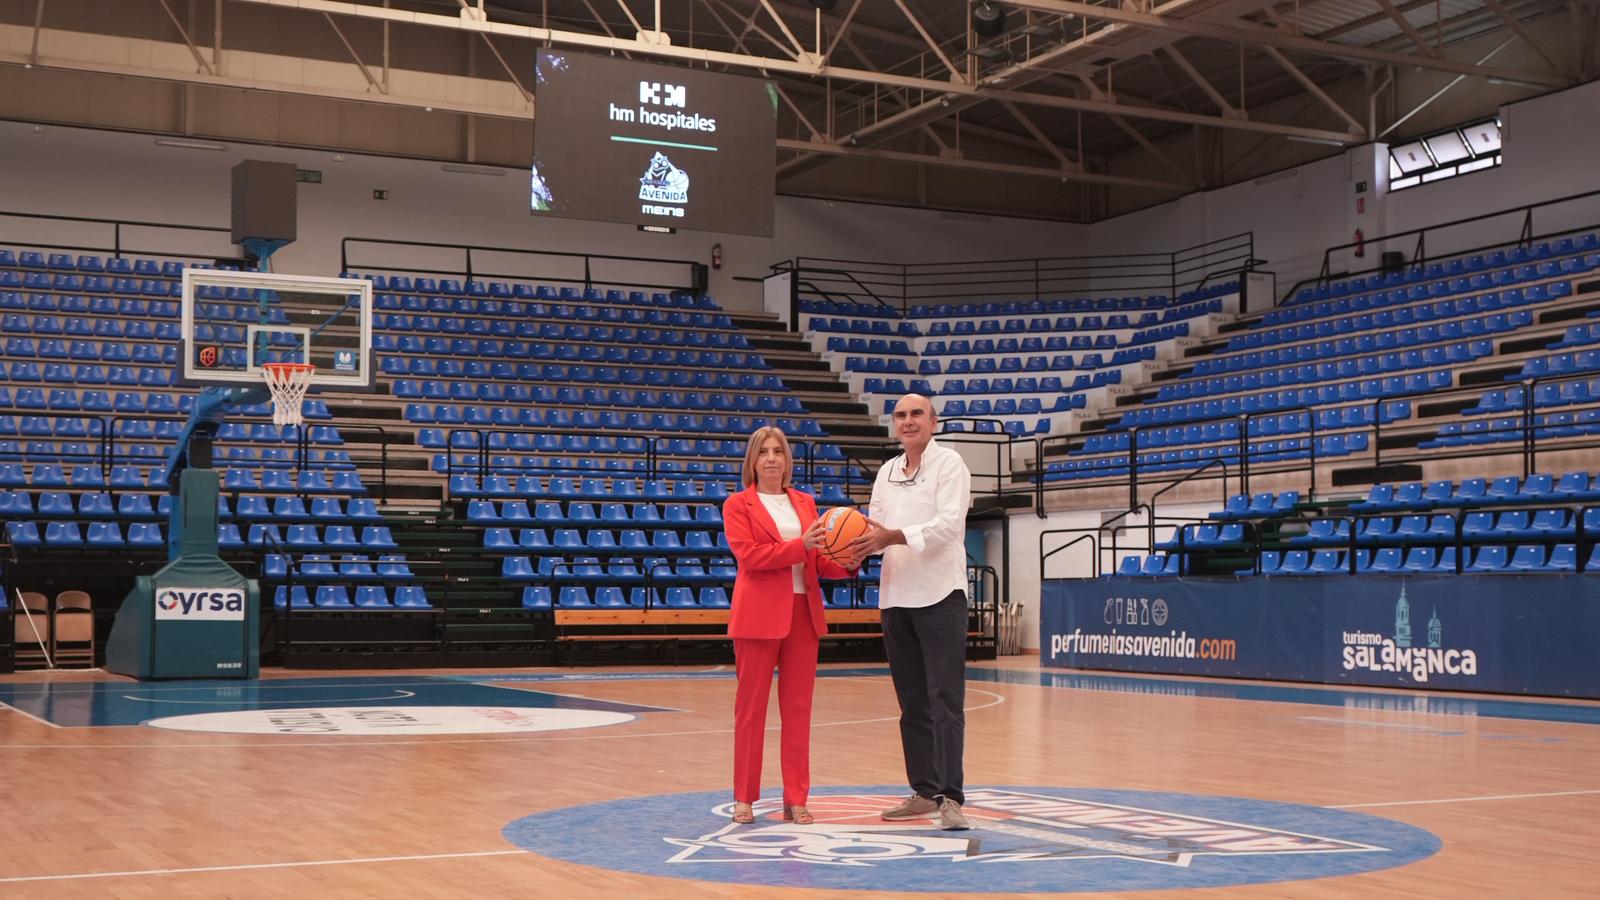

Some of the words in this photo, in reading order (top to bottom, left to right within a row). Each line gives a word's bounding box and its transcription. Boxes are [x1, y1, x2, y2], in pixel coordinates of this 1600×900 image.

[609, 103, 635, 122] hm
[639, 106, 717, 132] hospitales
[641, 187, 686, 201] AVENIDA
[1342, 629, 1383, 646] turismo
